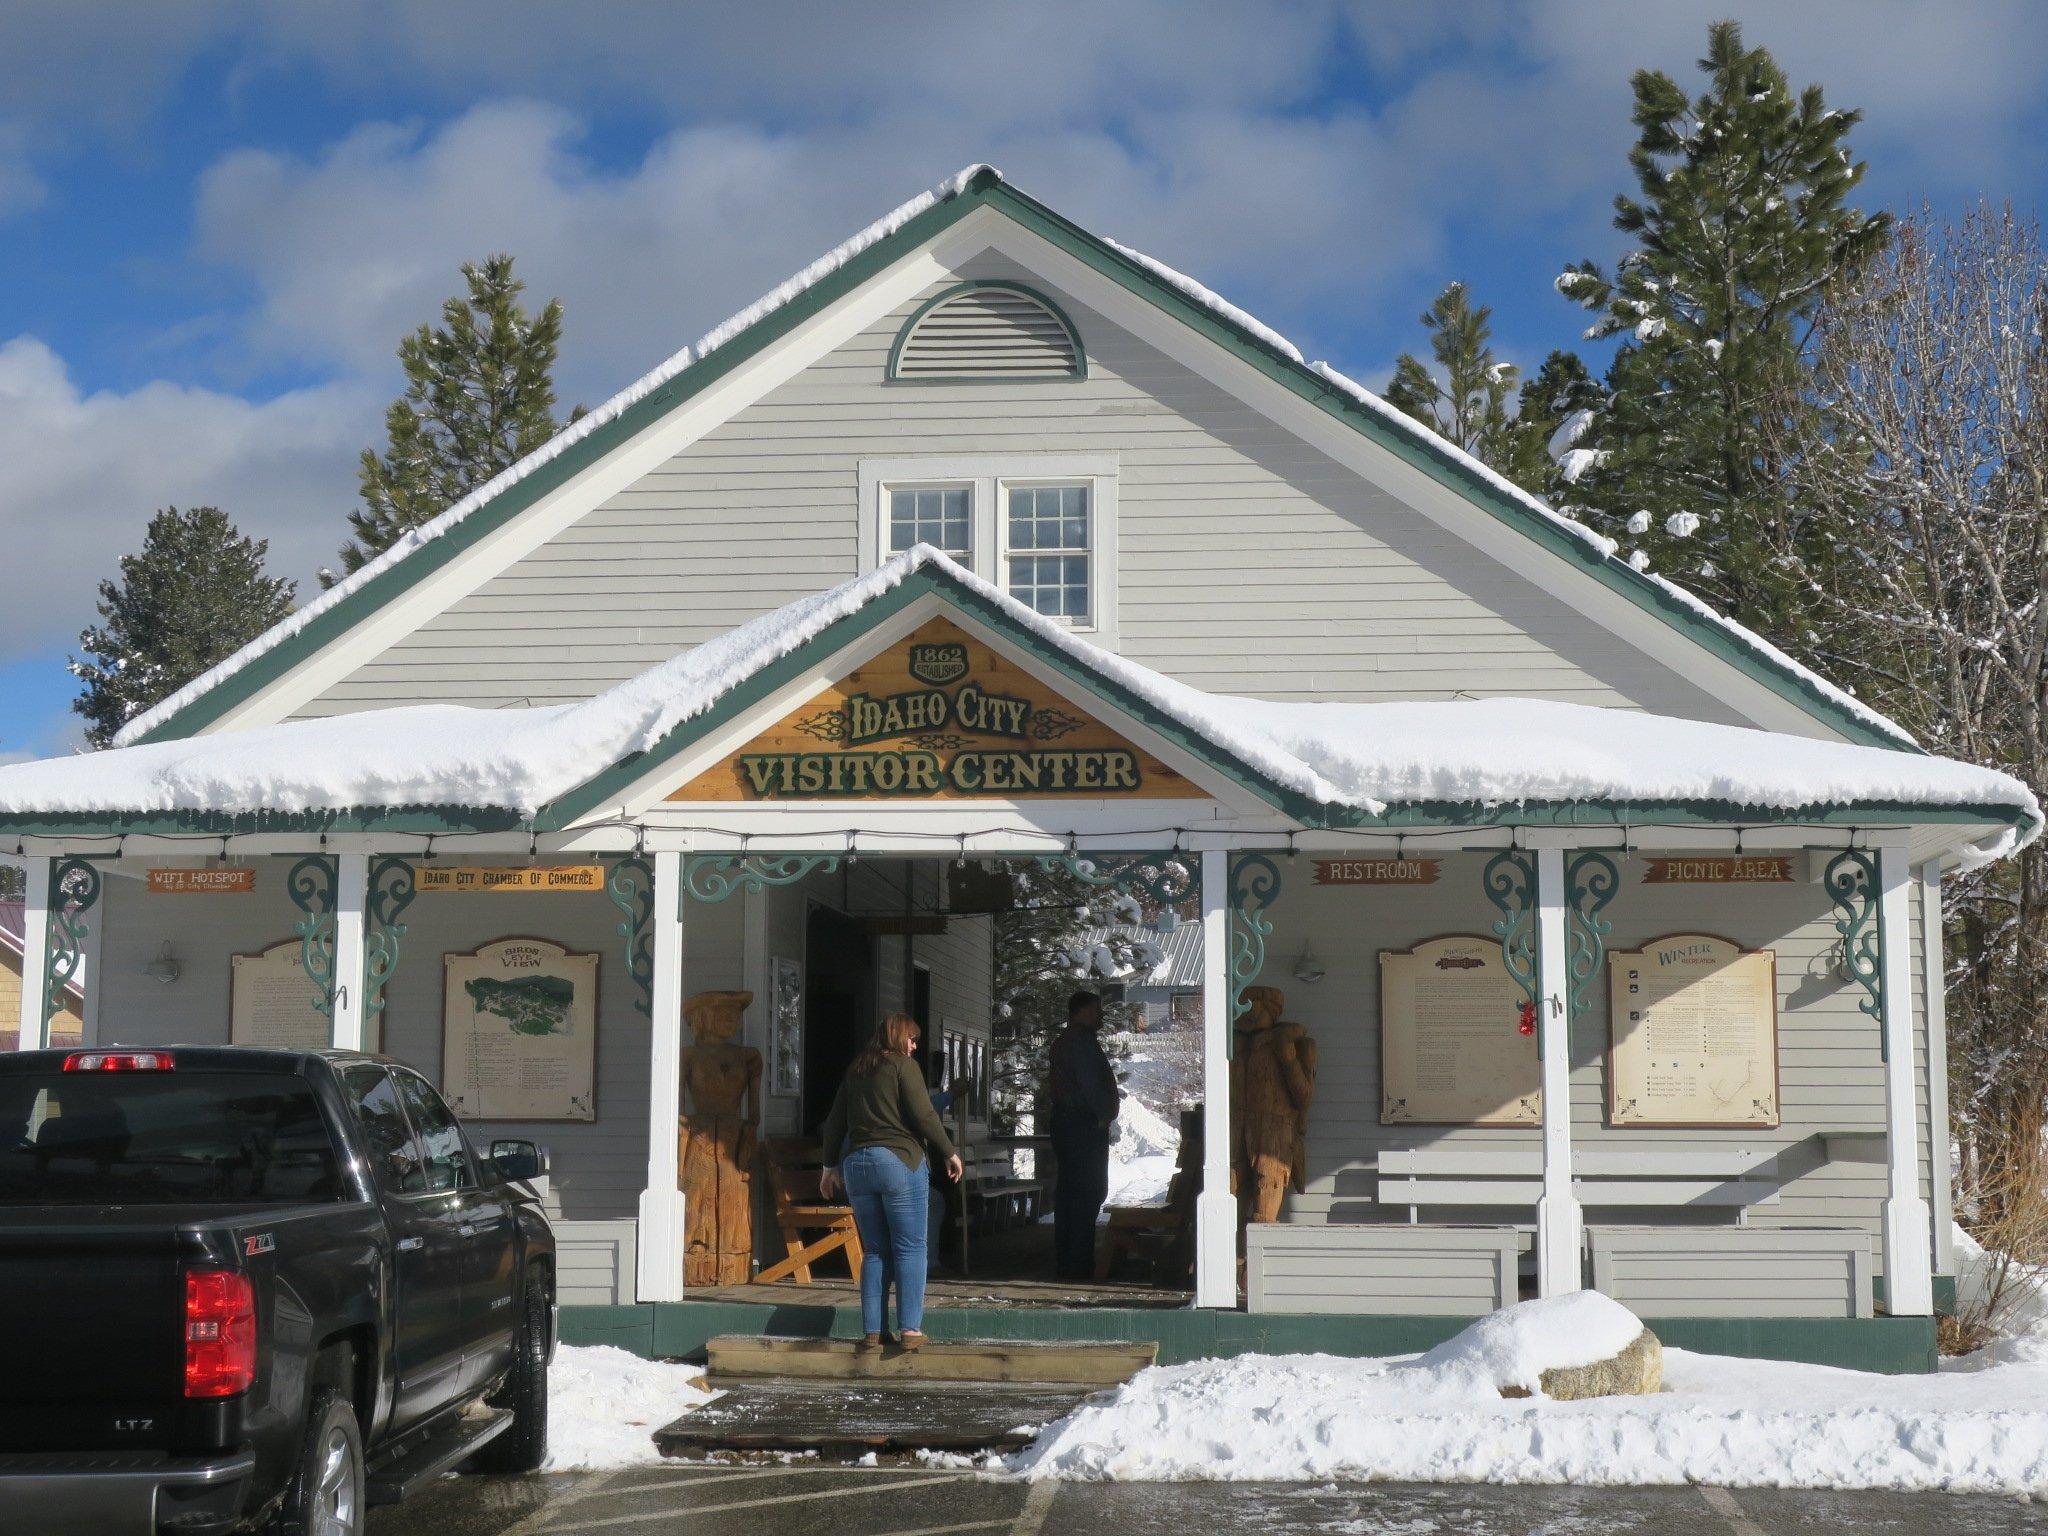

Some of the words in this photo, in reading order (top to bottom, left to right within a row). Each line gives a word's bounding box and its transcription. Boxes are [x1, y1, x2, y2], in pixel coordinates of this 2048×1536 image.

[915, 648, 962, 662] 1862
[916, 664, 963, 678] ESTABLISHED
[851, 693, 947, 739] IDAHO
[956, 688, 1027, 734] CITY
[743, 754, 939, 792] VISITOR
[950, 752, 1137, 789] CENTER
[1329, 862, 1422, 880] RESTROOM
[1666, 862, 1725, 879] PICNIC
[1730, 861, 1781, 879] AREA
[154, 872, 185, 883] WIFI
[191, 872, 245, 883] HOTSPOT
[424, 872, 450, 885] IDAHO
[456, 872, 475, 885] CITY
[483, 872, 523, 885] CHAMBER
[530, 872, 542, 885] OF
[548, 872, 594, 885] COMMERCE
[504, 946, 540, 955] BIRDS
[1658, 943, 1712, 966] WINTER
[501, 957, 542, 968] VIEW
[243, 1232, 276, 1256] Z71
[115, 1419, 153, 1431] LTZ
